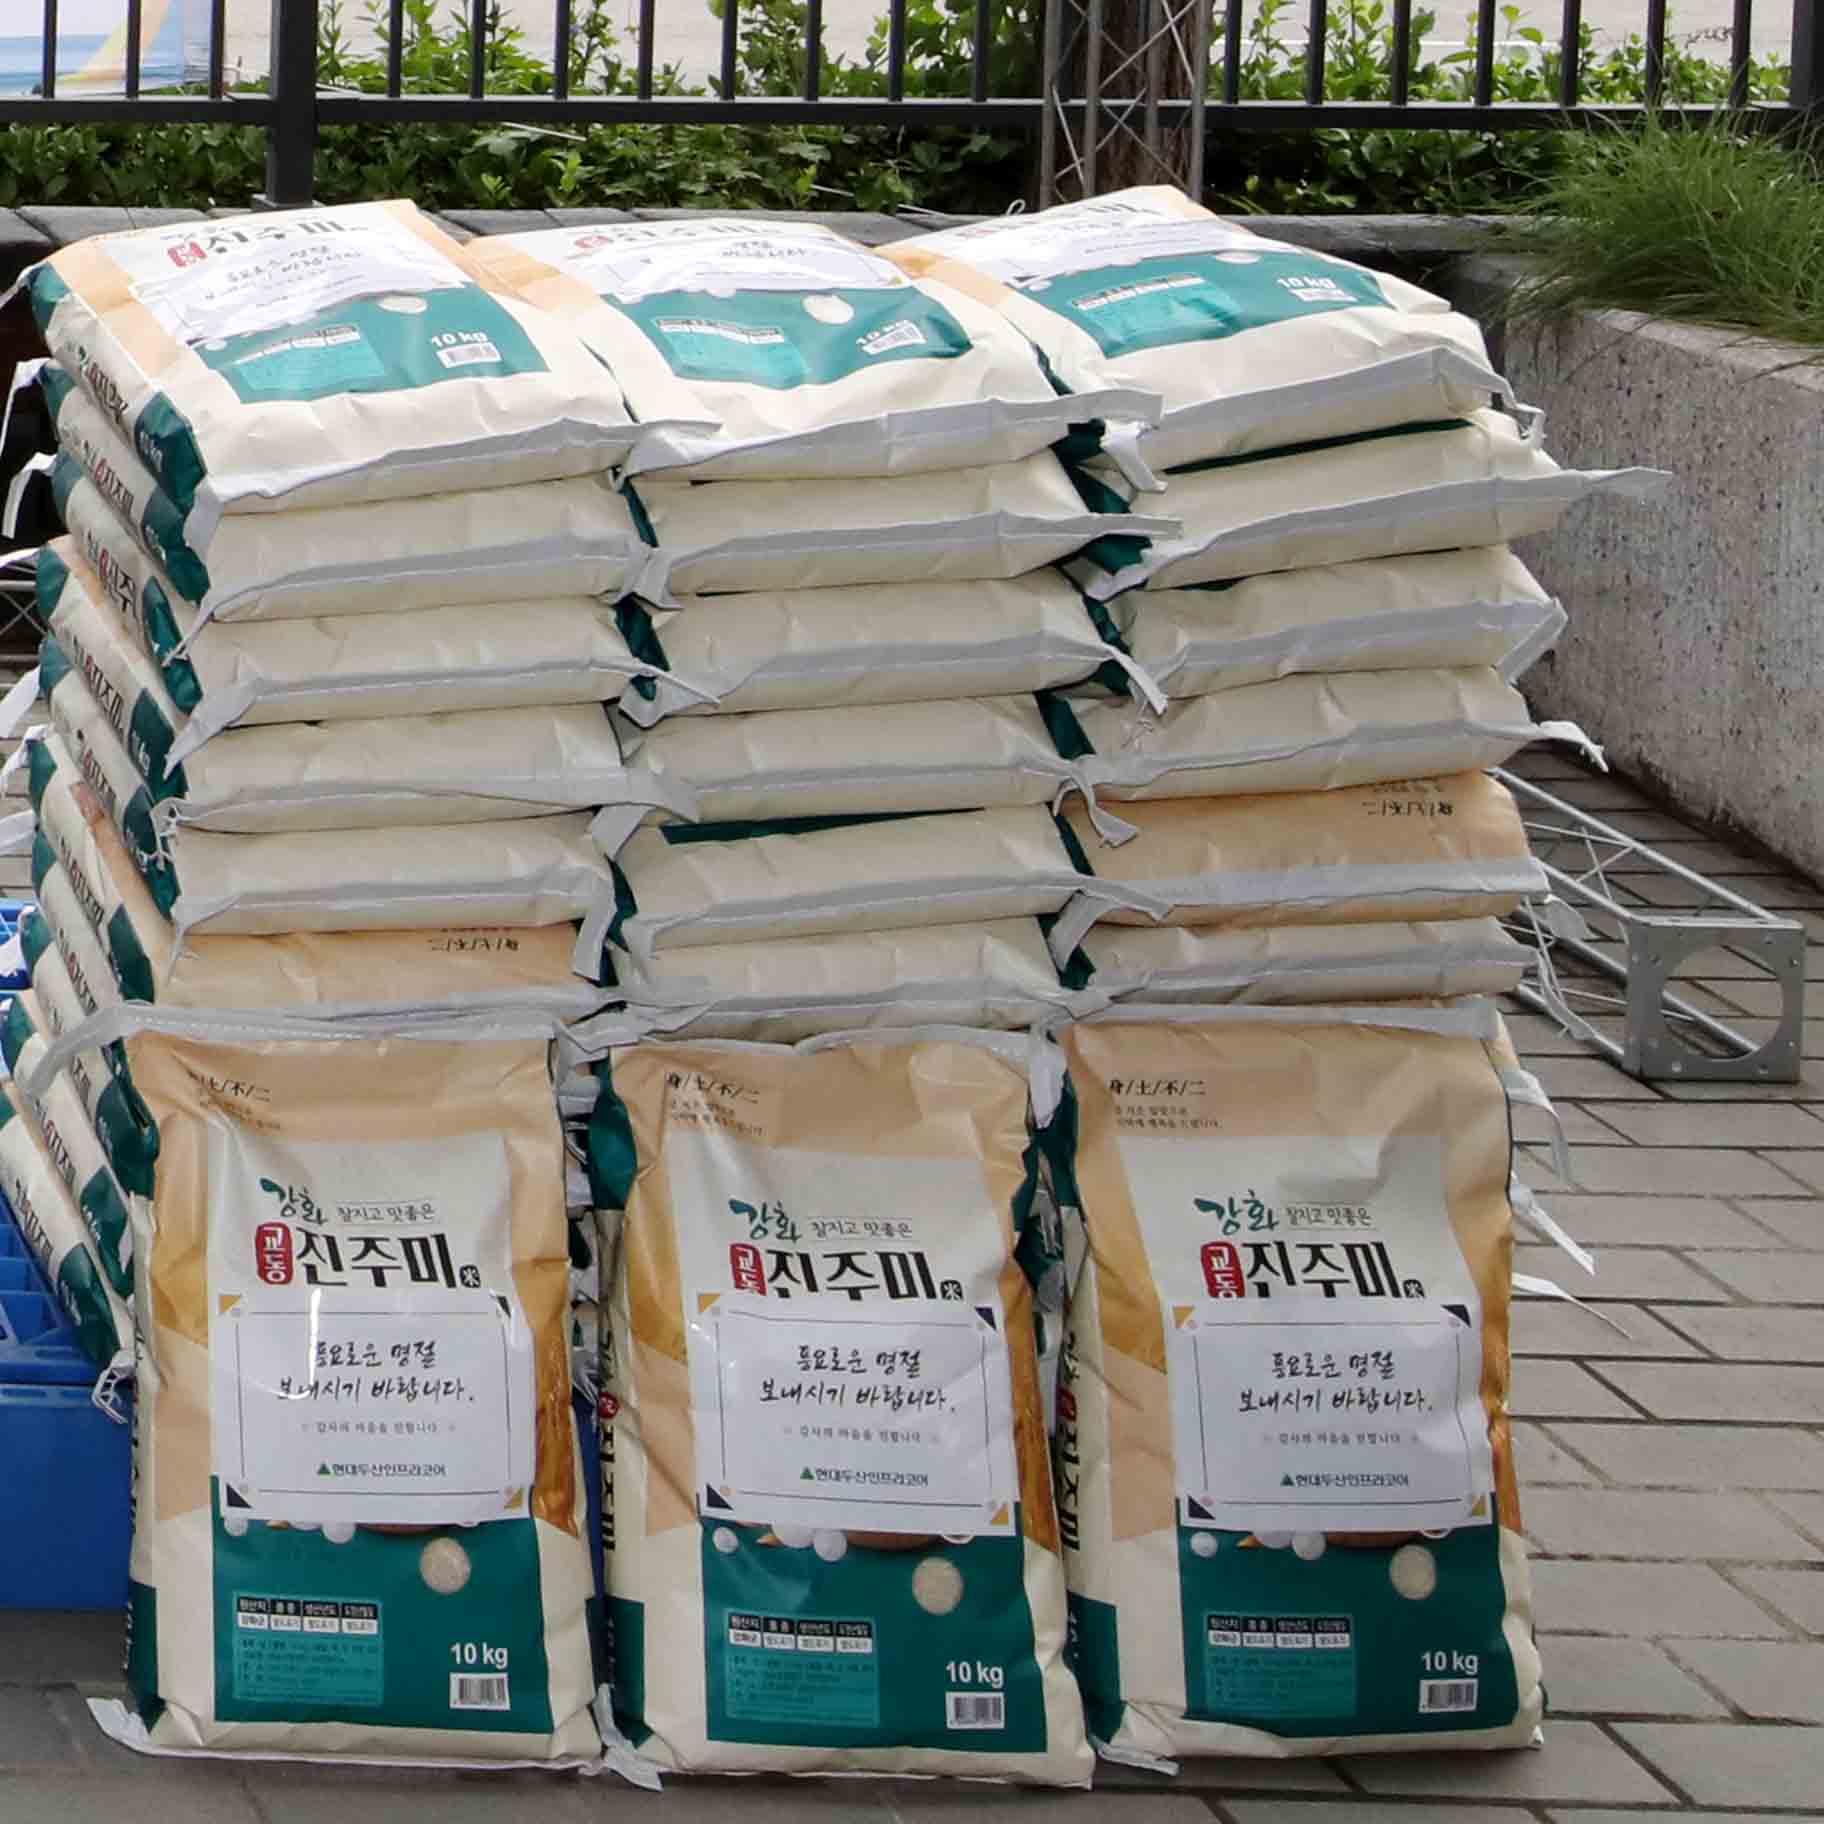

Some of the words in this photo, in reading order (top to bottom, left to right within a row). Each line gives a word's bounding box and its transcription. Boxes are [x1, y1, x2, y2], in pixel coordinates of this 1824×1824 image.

[259, 1177, 328, 1225] 강화
[1194, 1189, 1279, 1235] 강화
[729, 1197, 804, 1242] 강화
[295, 1227, 458, 1288] 진주미
[1243, 1240, 1403, 1299] 진주미
[766, 1248, 940, 1301] 진주미
[314, 1341, 383, 1368] 풍요로운
[389, 1341, 437, 1368] 명절
[796, 1346, 867, 1375] 풍요로운
[875, 1348, 921, 1379] 명절
[1271, 1350, 1342, 1379] 풍요로운
[1348, 1349, 1396, 1380] 명절
[760, 1379, 848, 1405] 보내시기
[1238, 1387, 1321, 1414] 보내시기
[451, 1643, 478, 1665] 10
[482, 1643, 509, 1669] kg
[1421, 1651, 1447, 1673] 10
[1451, 1649, 1480, 1675] kg
[945, 1661, 972, 1684] 10
[976, 1661, 1005, 1688] kg
